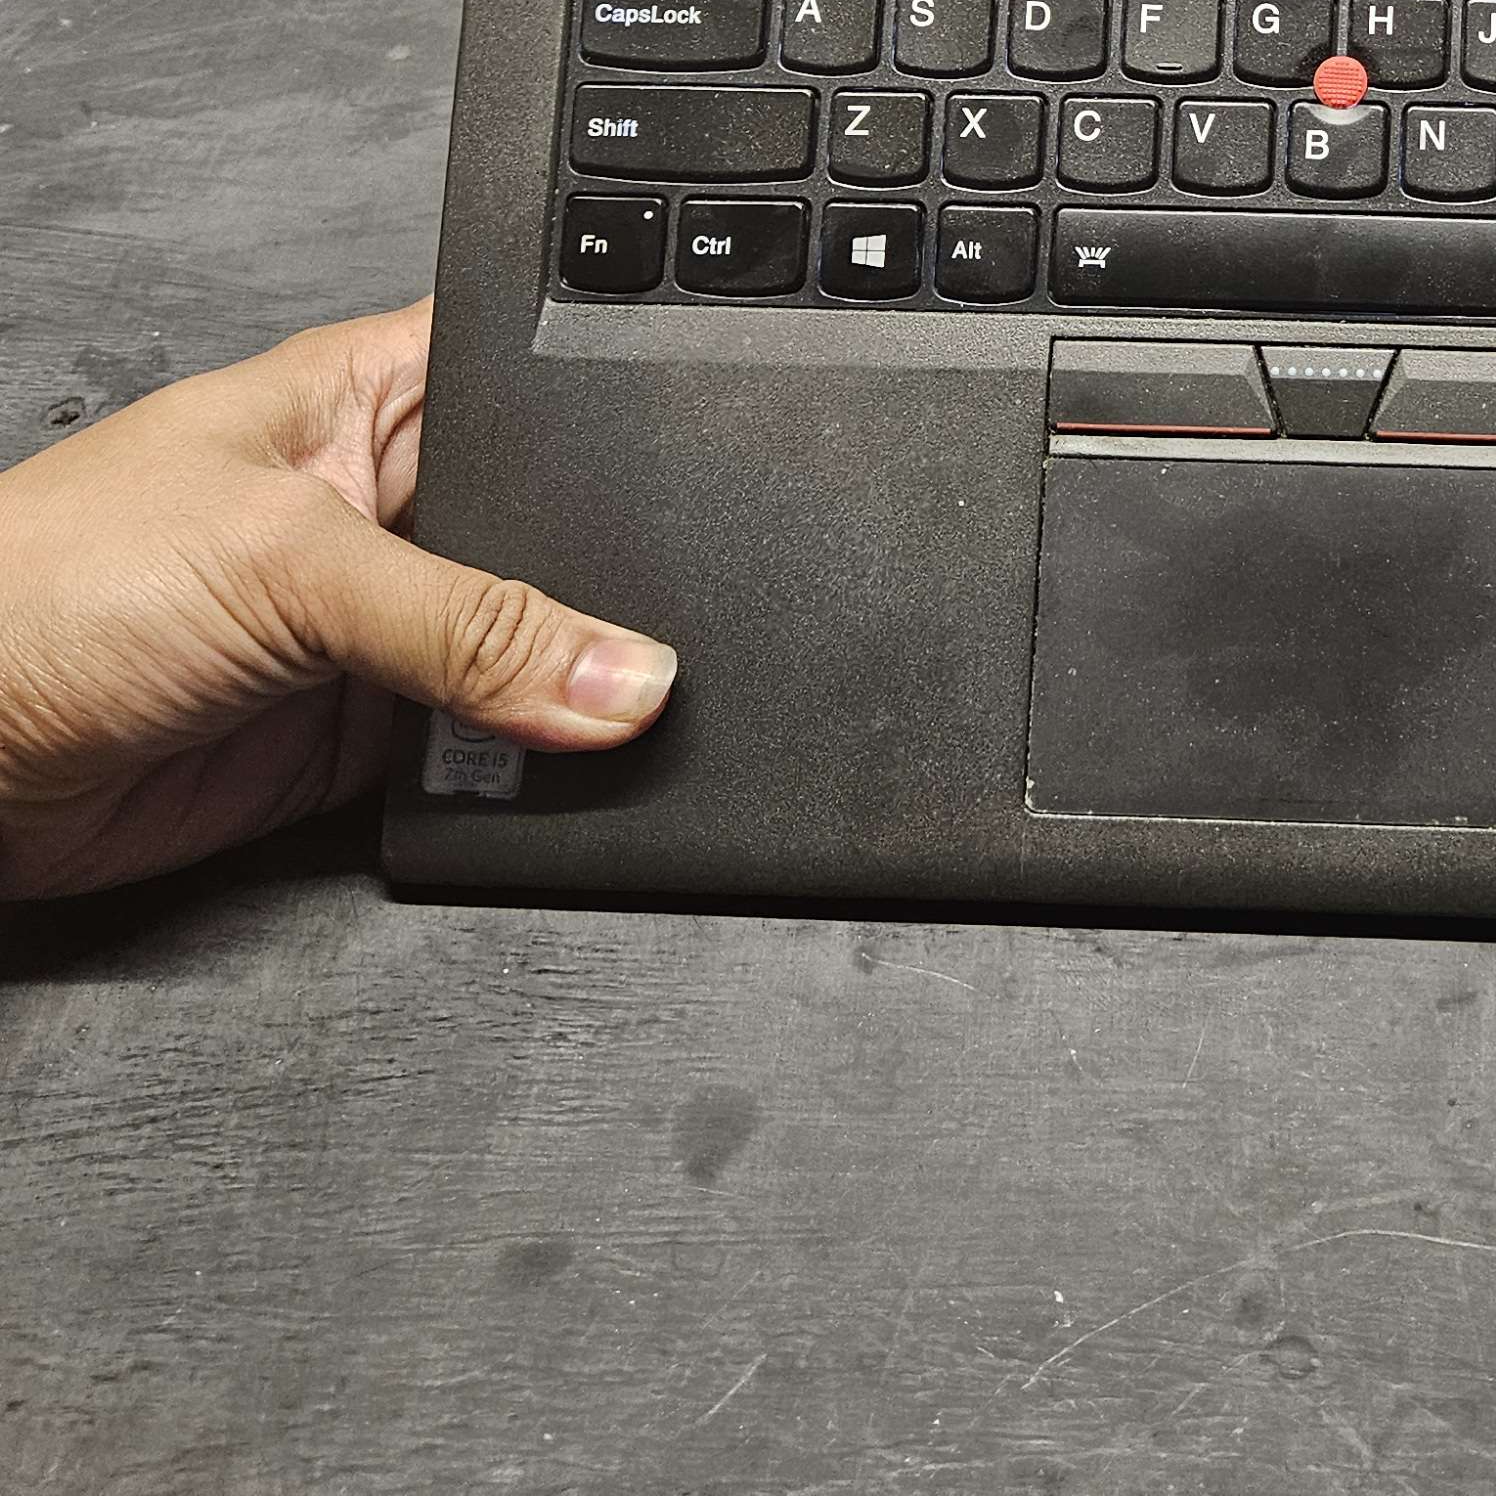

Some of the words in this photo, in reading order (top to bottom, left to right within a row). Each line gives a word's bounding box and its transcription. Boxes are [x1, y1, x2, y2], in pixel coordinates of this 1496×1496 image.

[595, 3, 702, 27] CapsLock
[1024, 0, 1051, 31] D
[1139, 3, 1164, 34] F
[1252, 2, 1280, 34] G
[1368, 5, 1394, 36] H
[587, 117, 639, 138] Shift
[844, 105, 871, 136] Z
[959, 107, 988, 139] X
[1073, 109, 1102, 142] C
[1188, 112, 1216, 144] V
[1419, 119, 1446, 151] N
[1304, 129, 1330, 160] B
[580, 234, 608, 254] Fn
[691, 235, 732, 255] Ctrl
[951, 240, 983, 260] Alt
[441, 747, 490, 768] CORE
